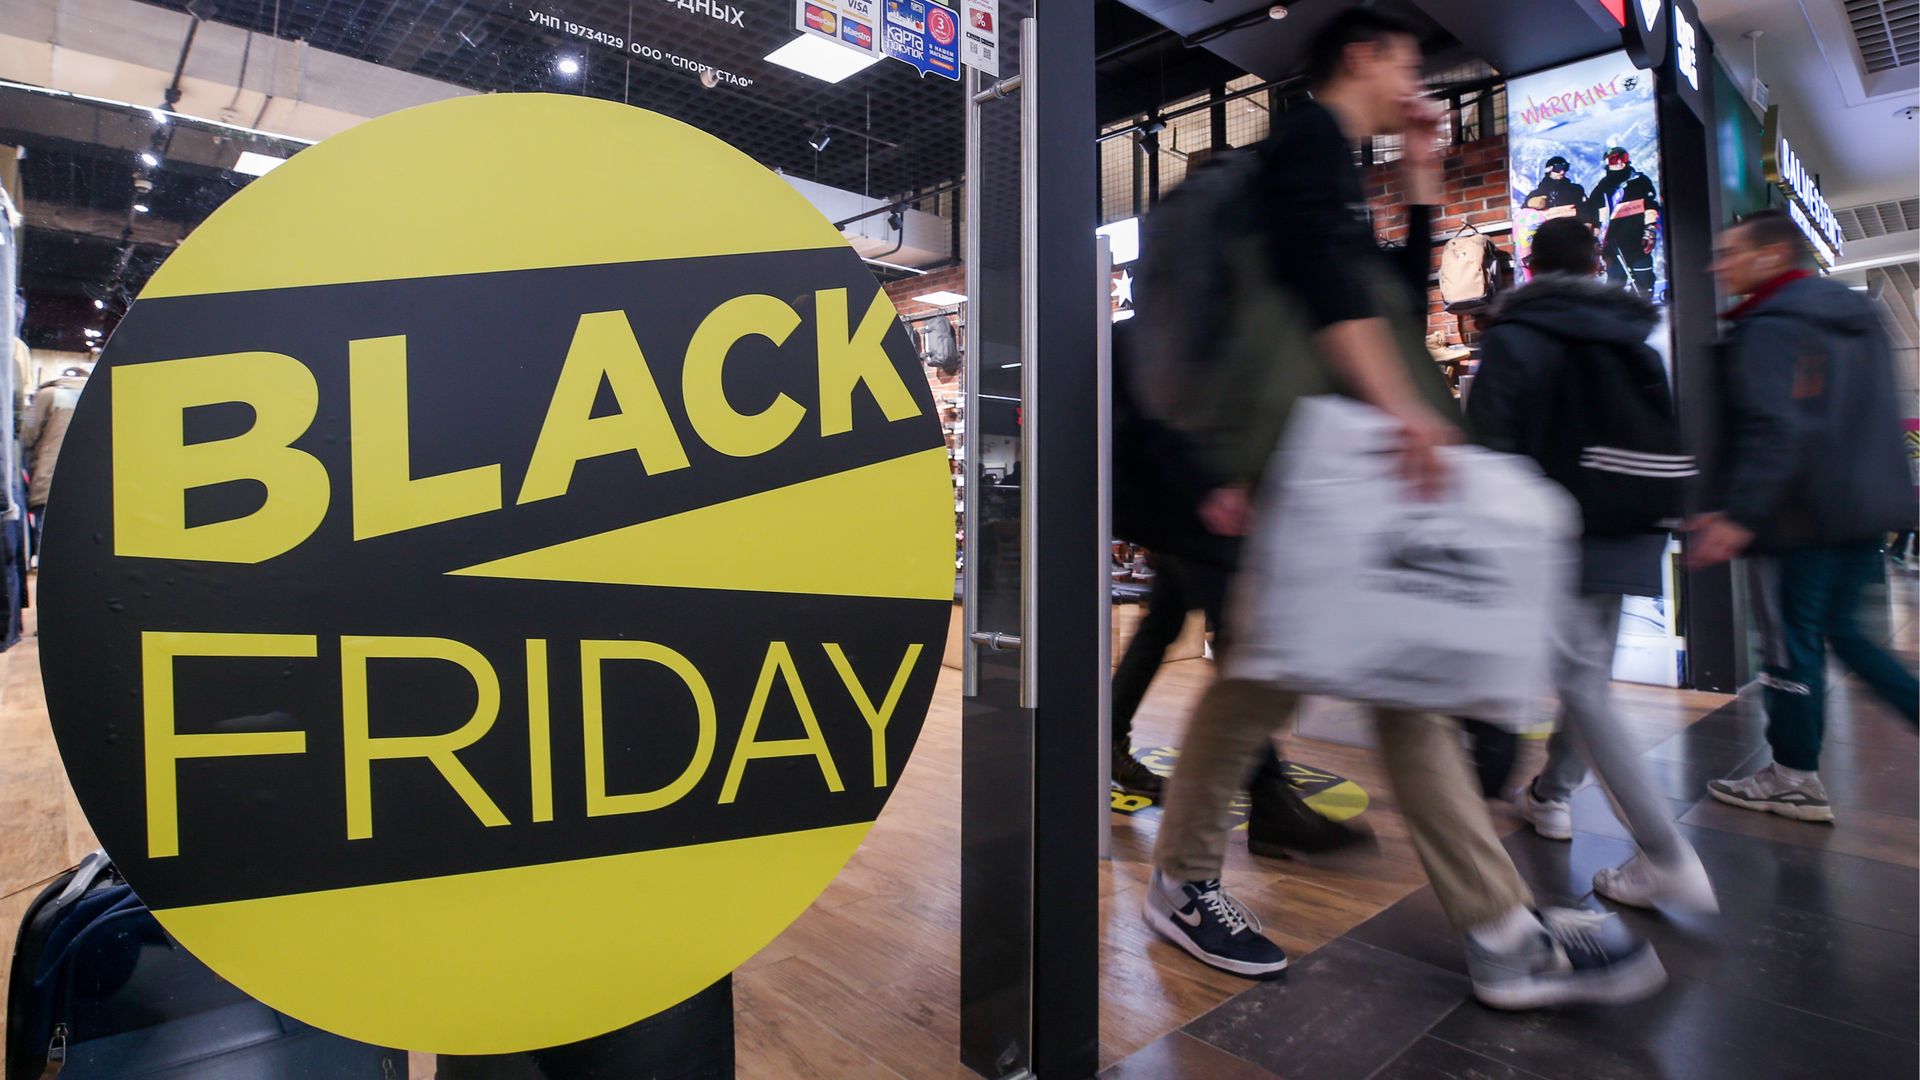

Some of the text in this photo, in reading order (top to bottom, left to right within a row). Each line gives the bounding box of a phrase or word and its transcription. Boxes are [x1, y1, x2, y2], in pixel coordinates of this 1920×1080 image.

[847, 0, 869, 15] VISA
[937, 17, 945, 31] 3
[529, 9, 754, 87] УНП 19734129 ООО "СПОРТ СТАФ"
[843, 25, 871, 43] Maestro
[1520, 74, 1620, 125] WARPAINT
[111, 287, 922, 564] BLACK
[141, 631, 924, 859] FRIDAY
